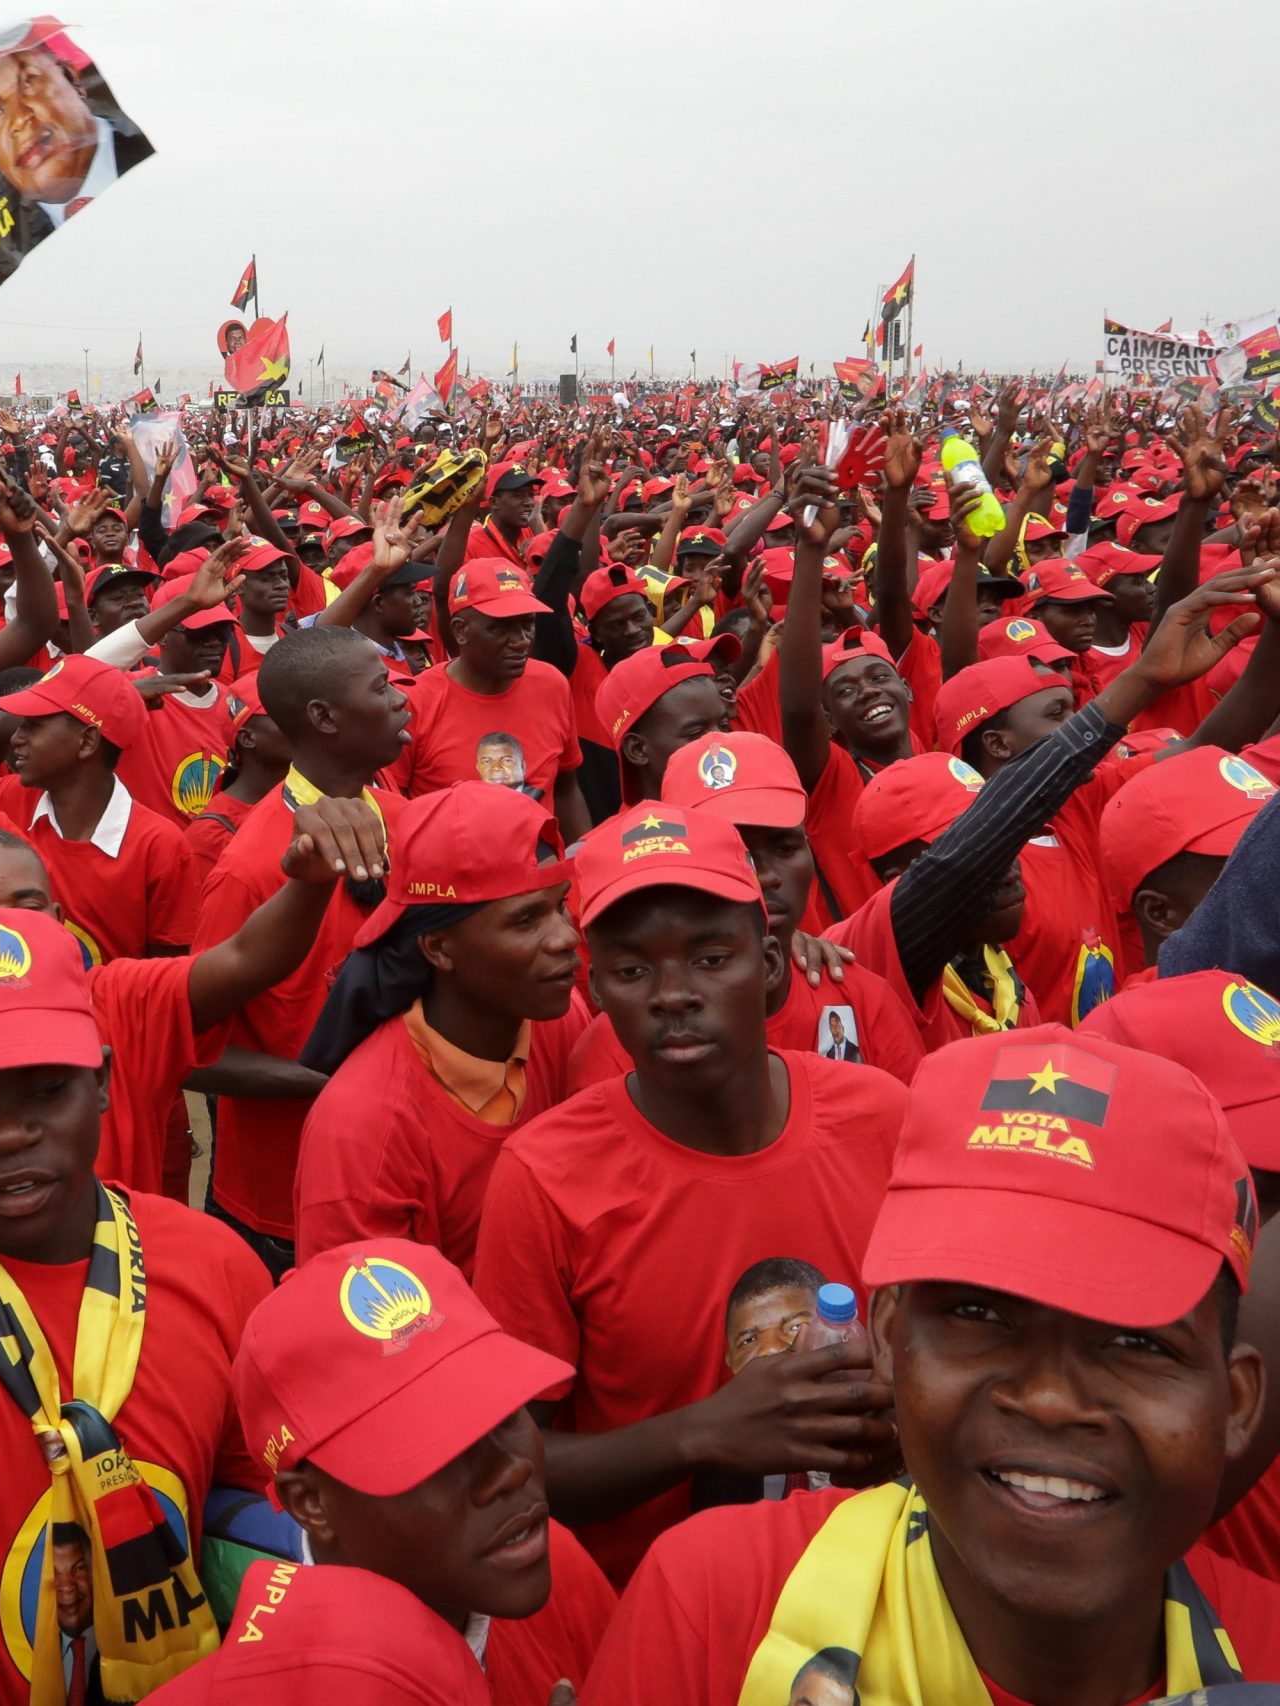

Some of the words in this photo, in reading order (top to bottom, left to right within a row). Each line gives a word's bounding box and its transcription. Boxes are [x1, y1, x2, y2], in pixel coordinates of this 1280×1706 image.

[72, 703, 103, 728] JMPLA
[956, 706, 989, 731] JMPLA
[623, 841, 690, 862] MPLA
[634, 835, 674, 847] VOTA
[408, 882, 457, 899] JMPLA
[1002, 1112, 1069, 1133] VOTA
[968, 1125, 1093, 1164] MPLA
[388, 1307, 418, 1328] ANGOLA
[396, 1316, 427, 1339] JMPLA
[238, 1562, 298, 1643] MPLA
